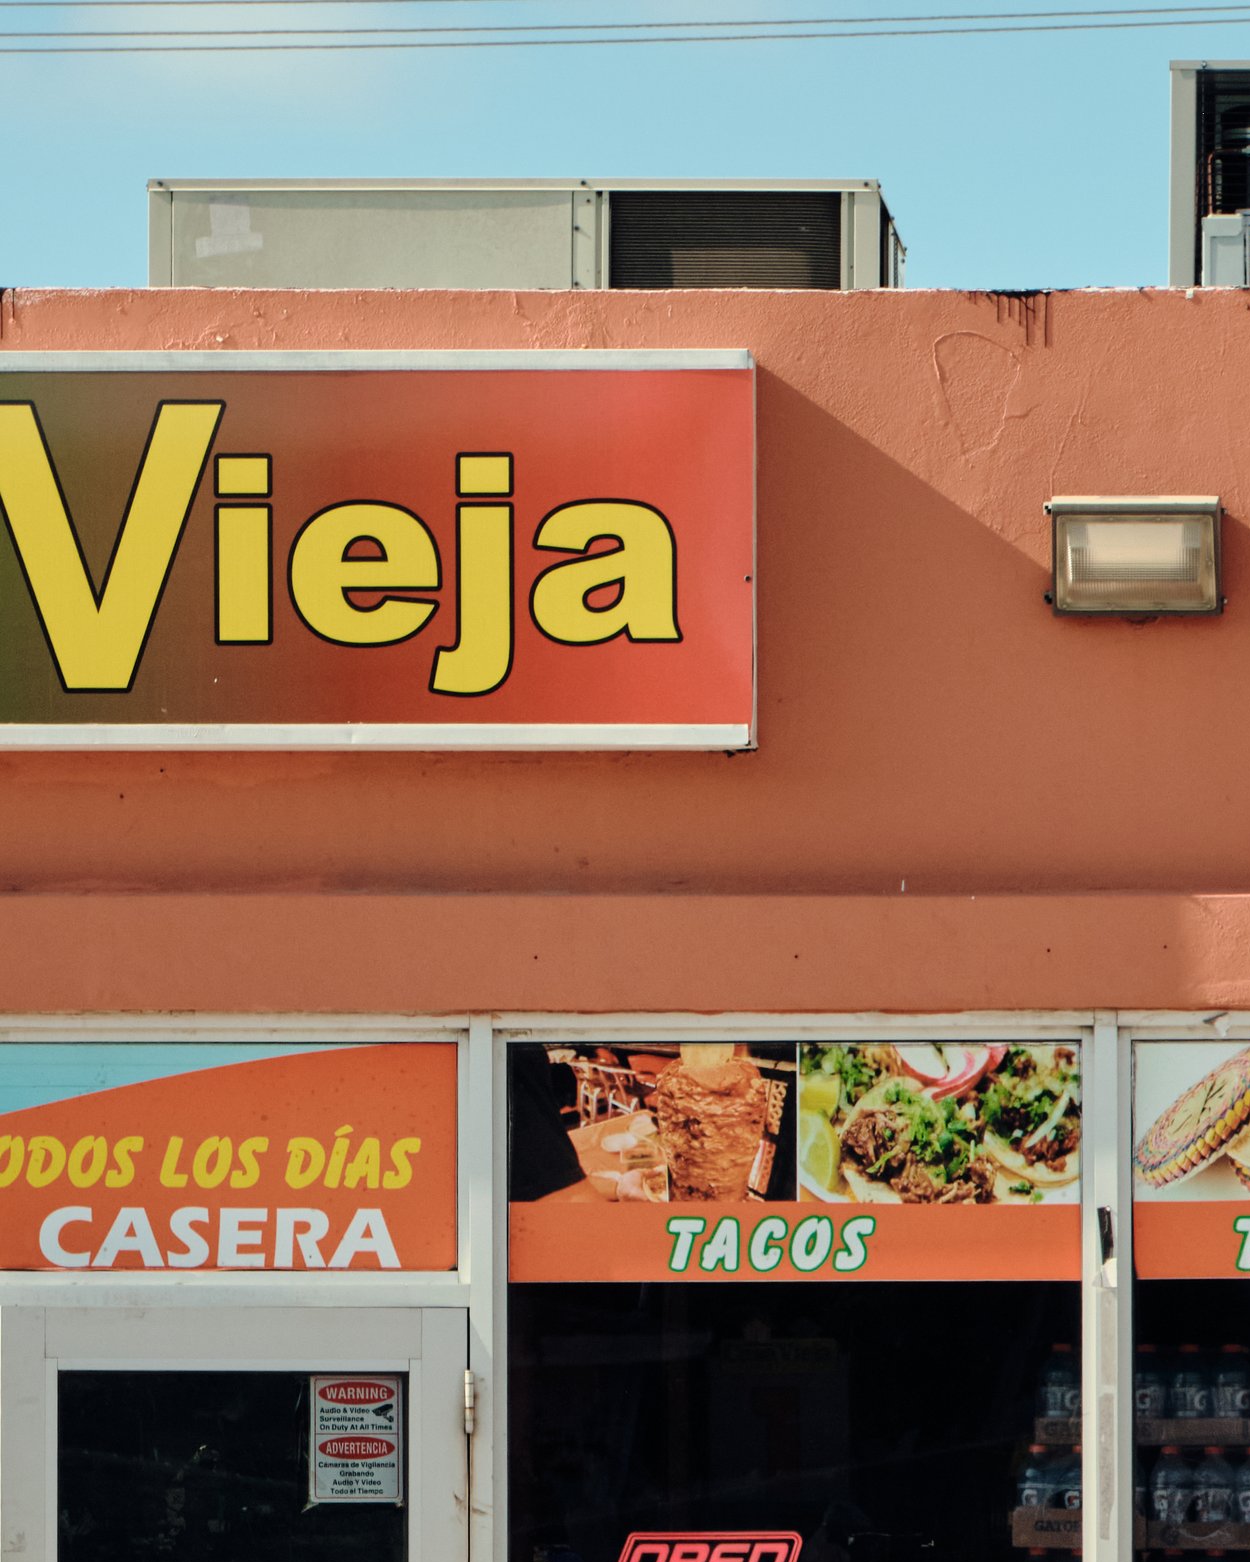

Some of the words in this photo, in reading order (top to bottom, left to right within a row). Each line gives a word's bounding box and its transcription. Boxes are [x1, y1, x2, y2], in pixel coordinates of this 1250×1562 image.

[0, 398, 683, 697] Vieja
[160, 1136, 269, 1189] LOS
[285, 1124, 421, 1189] DÍAS
[39, 1206, 402, 1268] CASERA
[666, 1215, 876, 1273] TACOS
[326, 1386, 388, 1400] WARNING
[332, 1424, 348, 1432] Duty
[326, 1442, 388, 1454] ADVERTENCIA
[361, 1461, 396, 1469] Vigilancia
